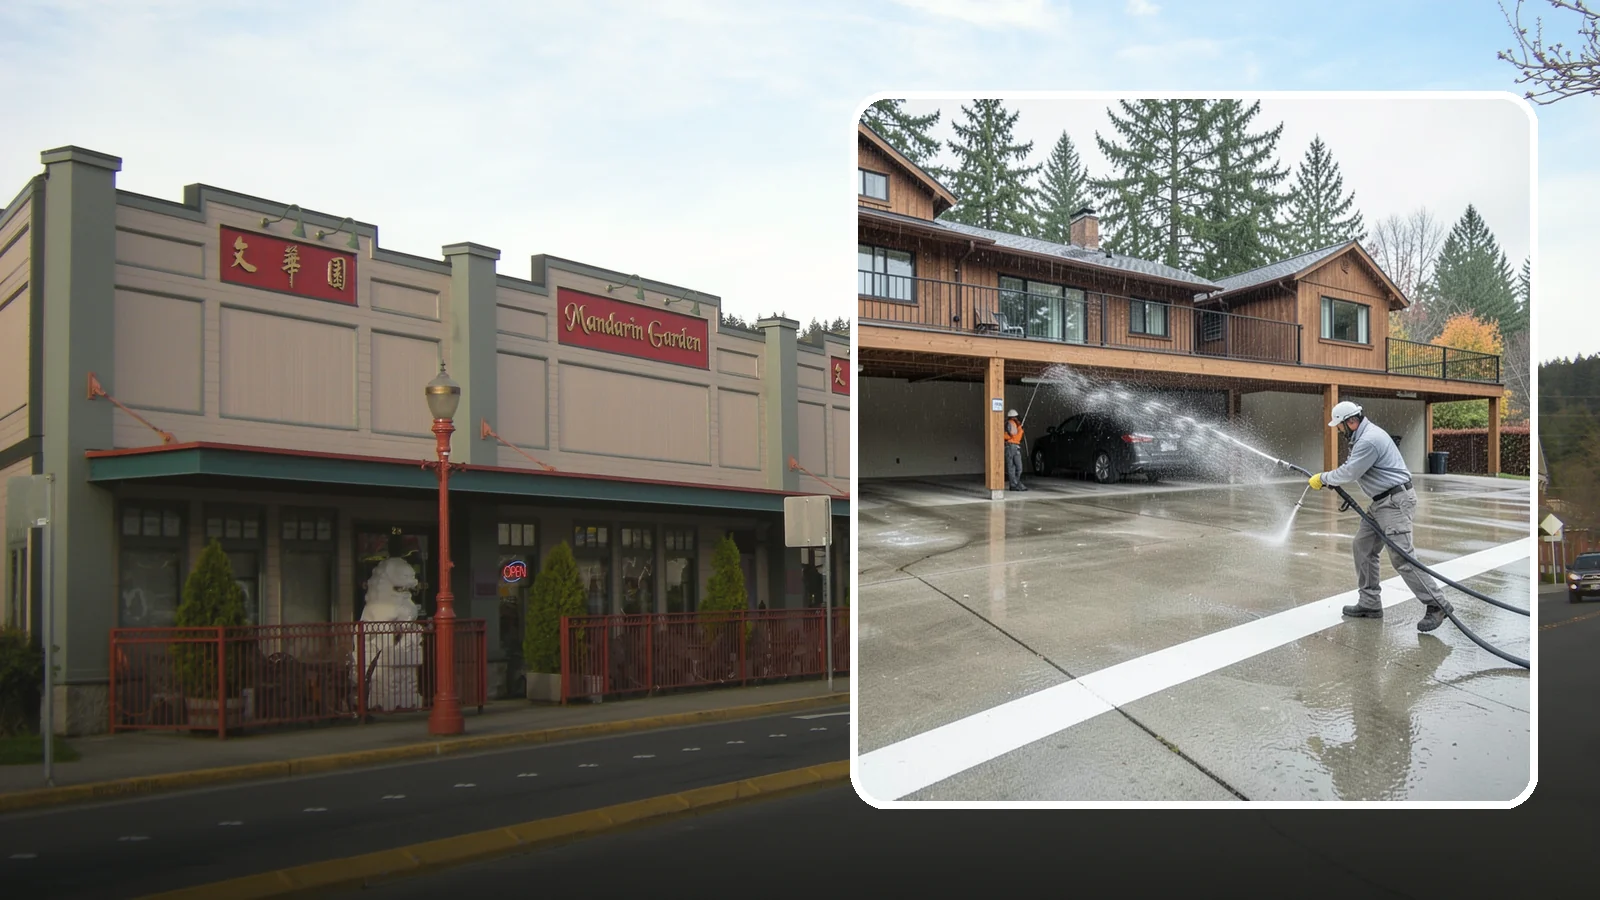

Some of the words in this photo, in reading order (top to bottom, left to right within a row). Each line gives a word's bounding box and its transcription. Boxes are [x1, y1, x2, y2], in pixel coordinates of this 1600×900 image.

[230, 235, 346, 291] 文華園
[564, 302, 644, 341] Mandarin
[647, 320, 701, 352] Garden
[503, 565, 527, 578] OPEN
